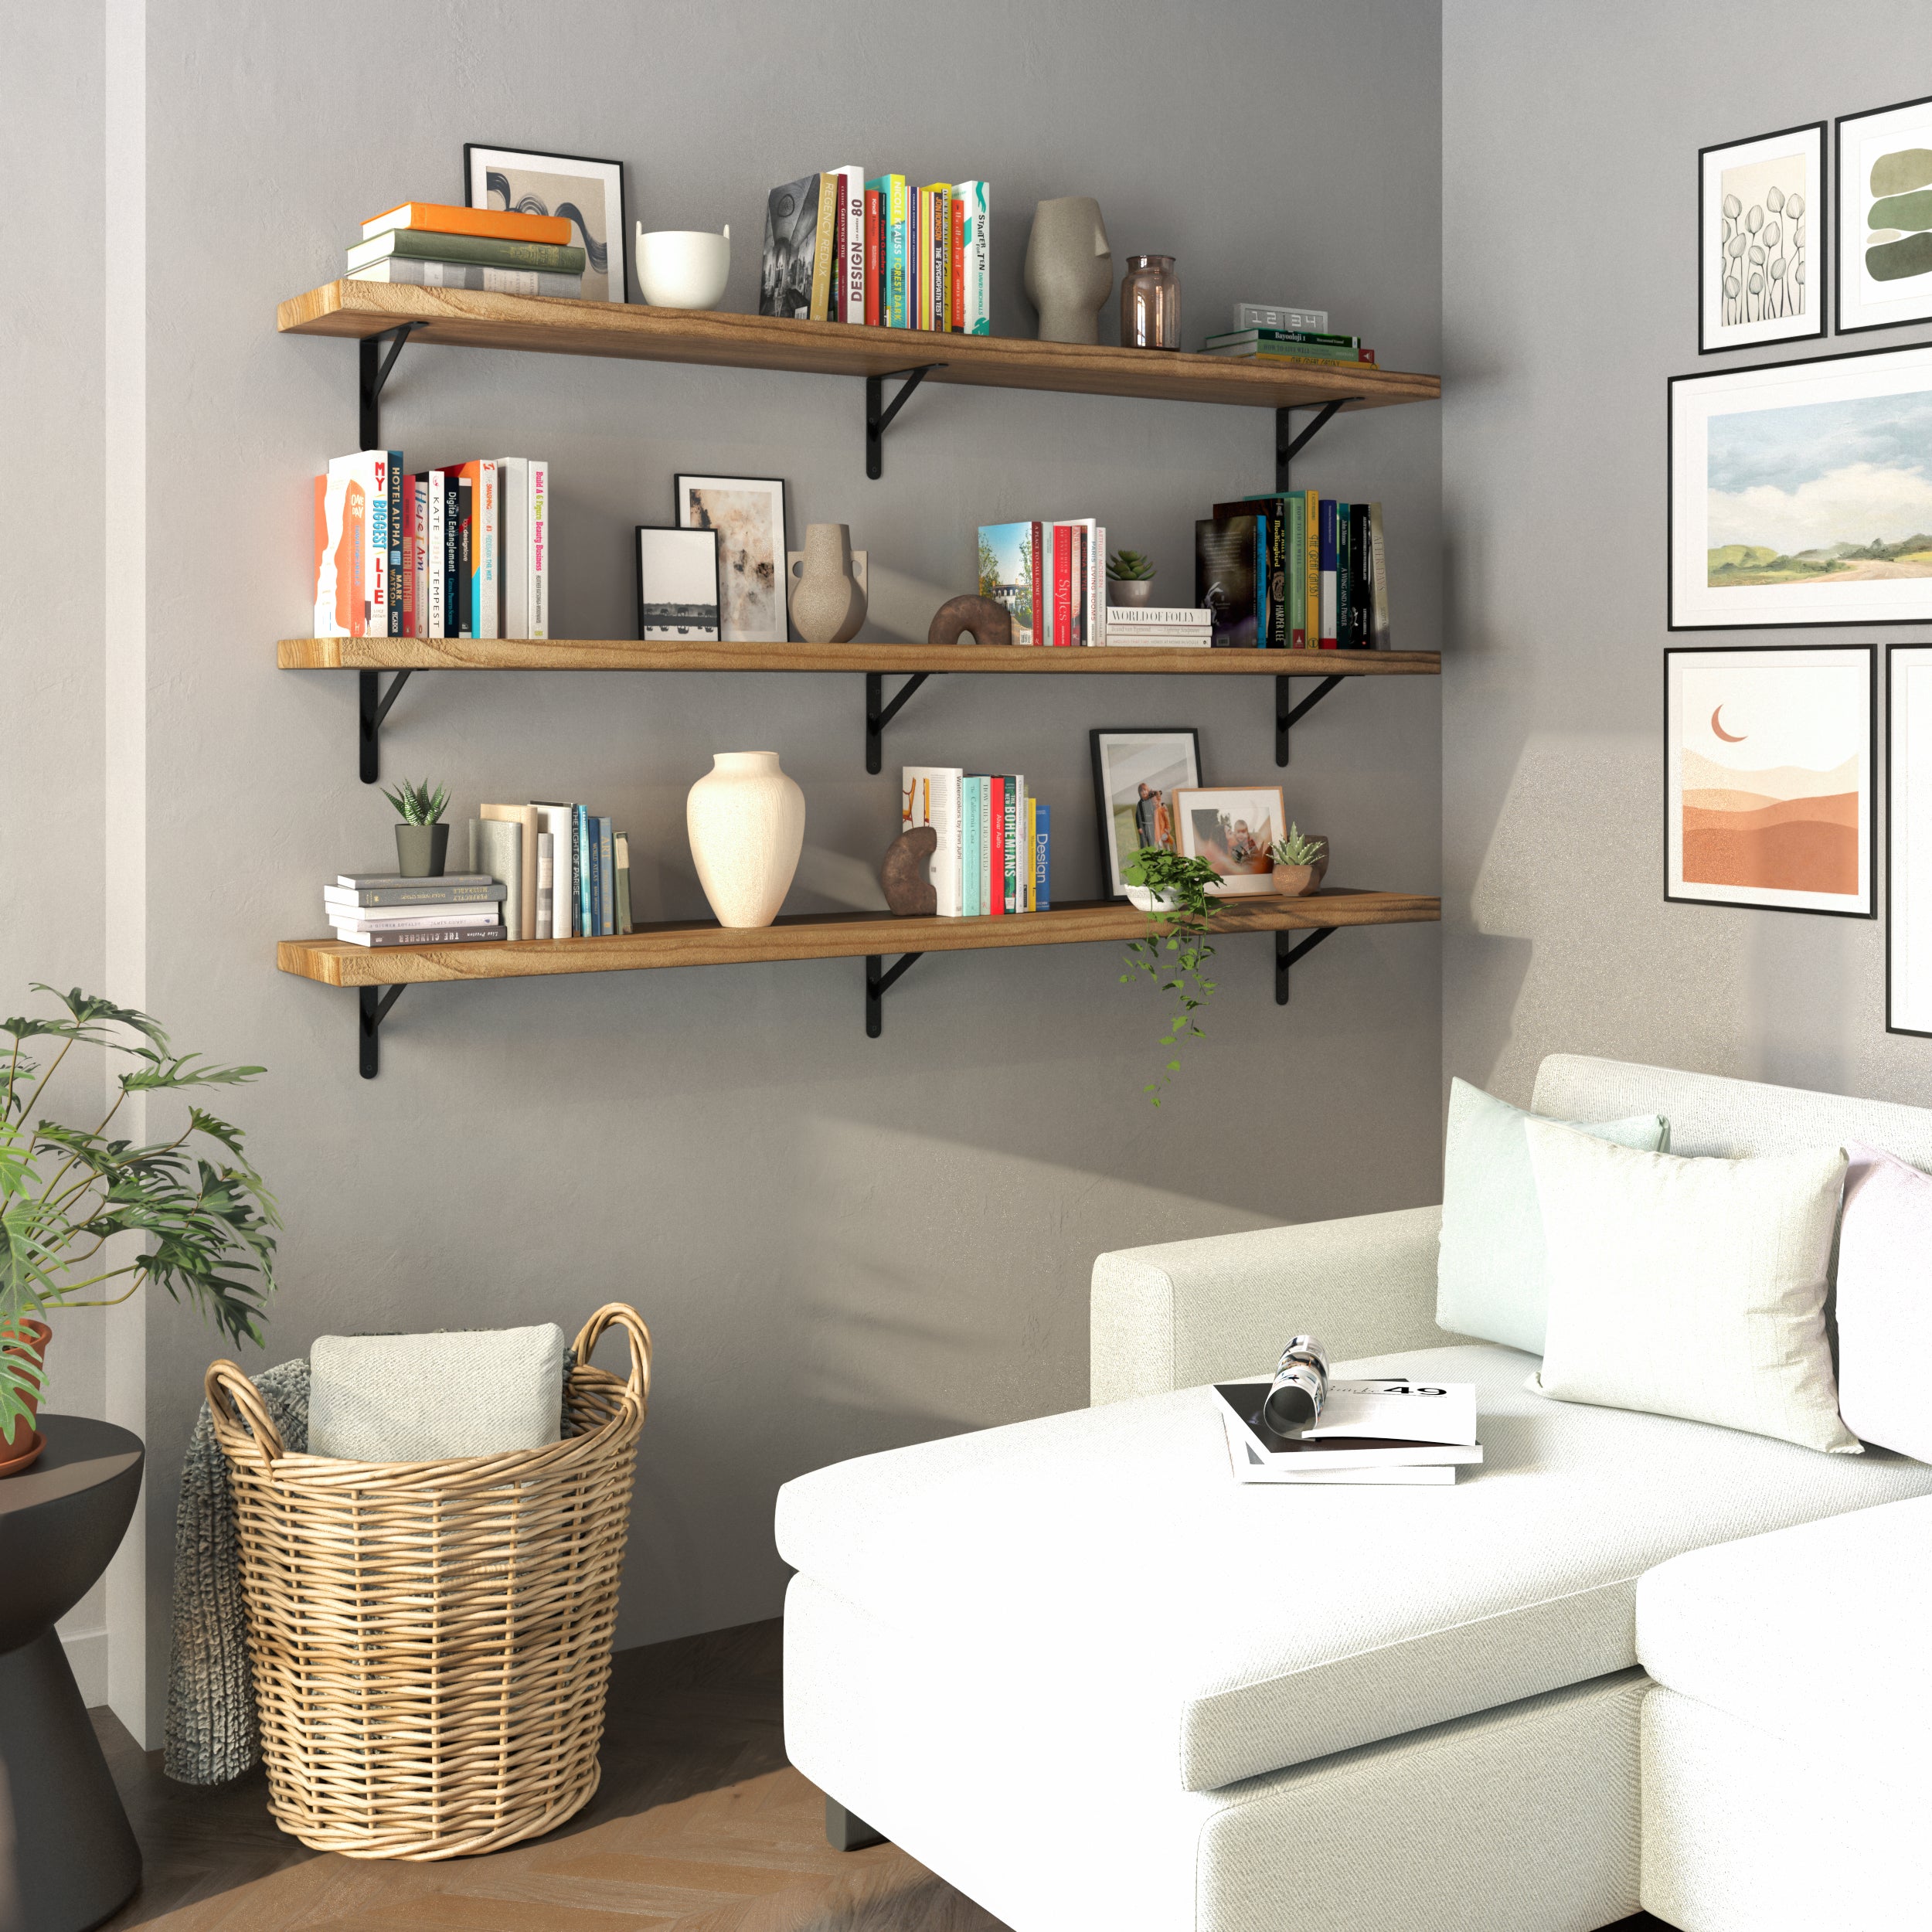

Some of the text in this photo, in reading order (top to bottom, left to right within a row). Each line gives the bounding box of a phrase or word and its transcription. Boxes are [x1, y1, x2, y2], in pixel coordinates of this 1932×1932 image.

[894, 181, 903, 214] NICOLE
[818, 182, 835, 277] REGENCY REDUX
[977, 214, 986, 248] STARTER
[851, 199, 863, 302] DESIGN 80
[977, 253, 985, 270] TEN
[1275, 332, 1302, 342] Bayooloji
[375, 461, 385, 492] MY
[351, 494, 365, 506] ONE
[352, 506, 364, 519] DAY
[392, 467, 400, 547] HOTEL ALPHA
[534, 500, 543, 521] Figure
[372, 499, 387, 549] BIGGEST
[415, 489, 427, 571] Here I Am
[446, 492, 457, 572] Digital Entanglement
[533, 521, 543, 543] Beauty
[1297, 522, 1302, 532] TO
[403, 536, 413, 570] NINETEEN
[1035, 551, 1040, 560] TO
[1308, 534, 1318, 598] THE GREAT GATSBY
[1373, 536, 1386, 593] AFTER DAYS
[374, 557, 384, 605] LIE
[403, 570, 413, 612] EIGHTY-FOUR
[1056, 579, 1070, 621] Styles
[1111, 610, 1194, 623] WORLD OF FOLLY
[1275, 604, 1284, 641] HARPER LEE
[956, 820, 962, 828] by
[601, 835, 611, 860] ART
[1005, 806, 1016, 877] BOHEMIANS
[1036, 833, 1048, 883] Design
[573, 854, 579, 865] OF
[398, 932, 460, 943] THE CLINCHER
